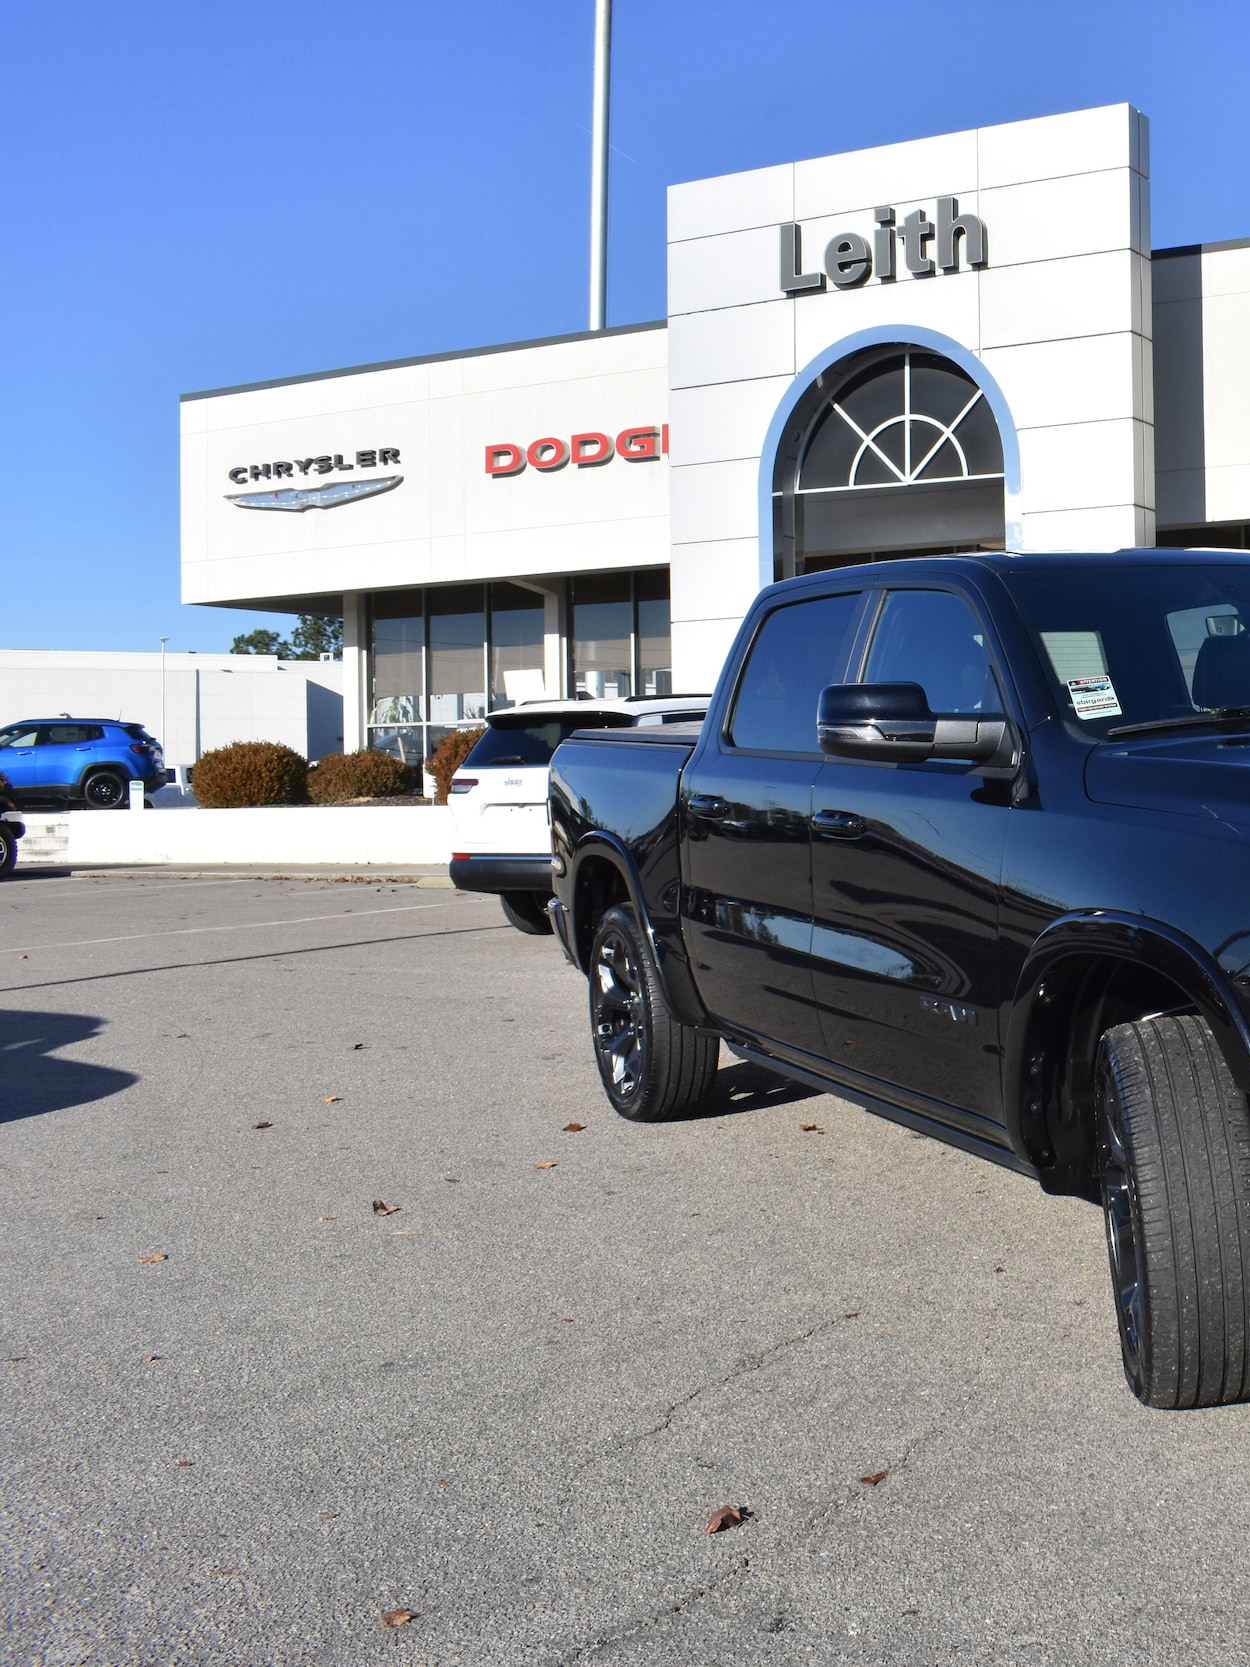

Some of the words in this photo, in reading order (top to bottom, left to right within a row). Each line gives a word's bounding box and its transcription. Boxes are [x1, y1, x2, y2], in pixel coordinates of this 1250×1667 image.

[780, 196, 989, 297] Leith
[228, 447, 401, 484] CHRYSLER
[485, 424, 669, 478] DODG
